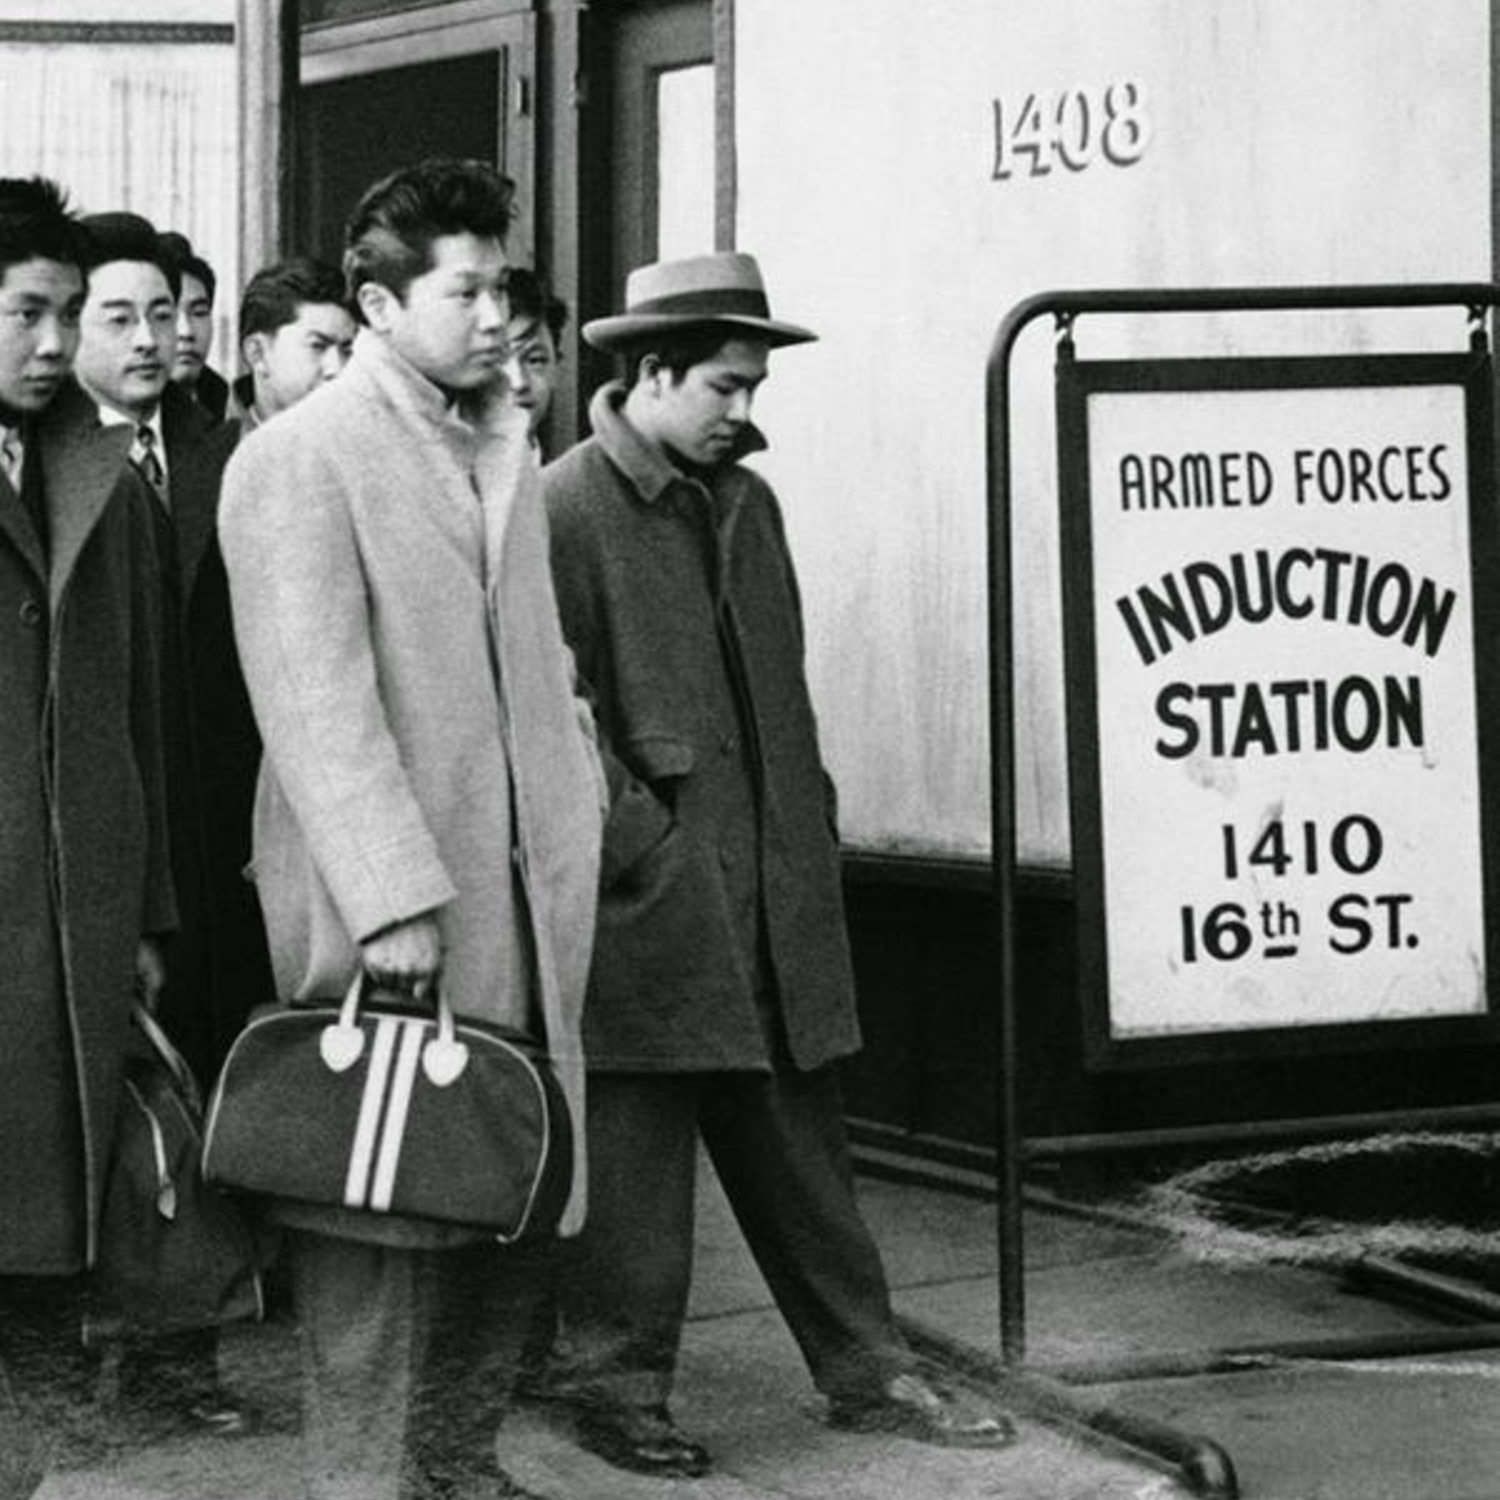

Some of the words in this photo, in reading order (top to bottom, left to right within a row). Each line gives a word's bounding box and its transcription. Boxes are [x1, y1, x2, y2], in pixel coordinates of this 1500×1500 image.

[992, 83, 1151, 182] 1408
[1120, 450, 1274, 511] ARMED
[1294, 444, 1451, 504] FORCES
[1116, 548, 1456, 667] INDUCTION
[1155, 675, 1424, 759] STATION
[1223, 814, 1383, 879] 1410
[1181, 901, 1300, 963] 16th
[1328, 893, 1419, 955] ST.
